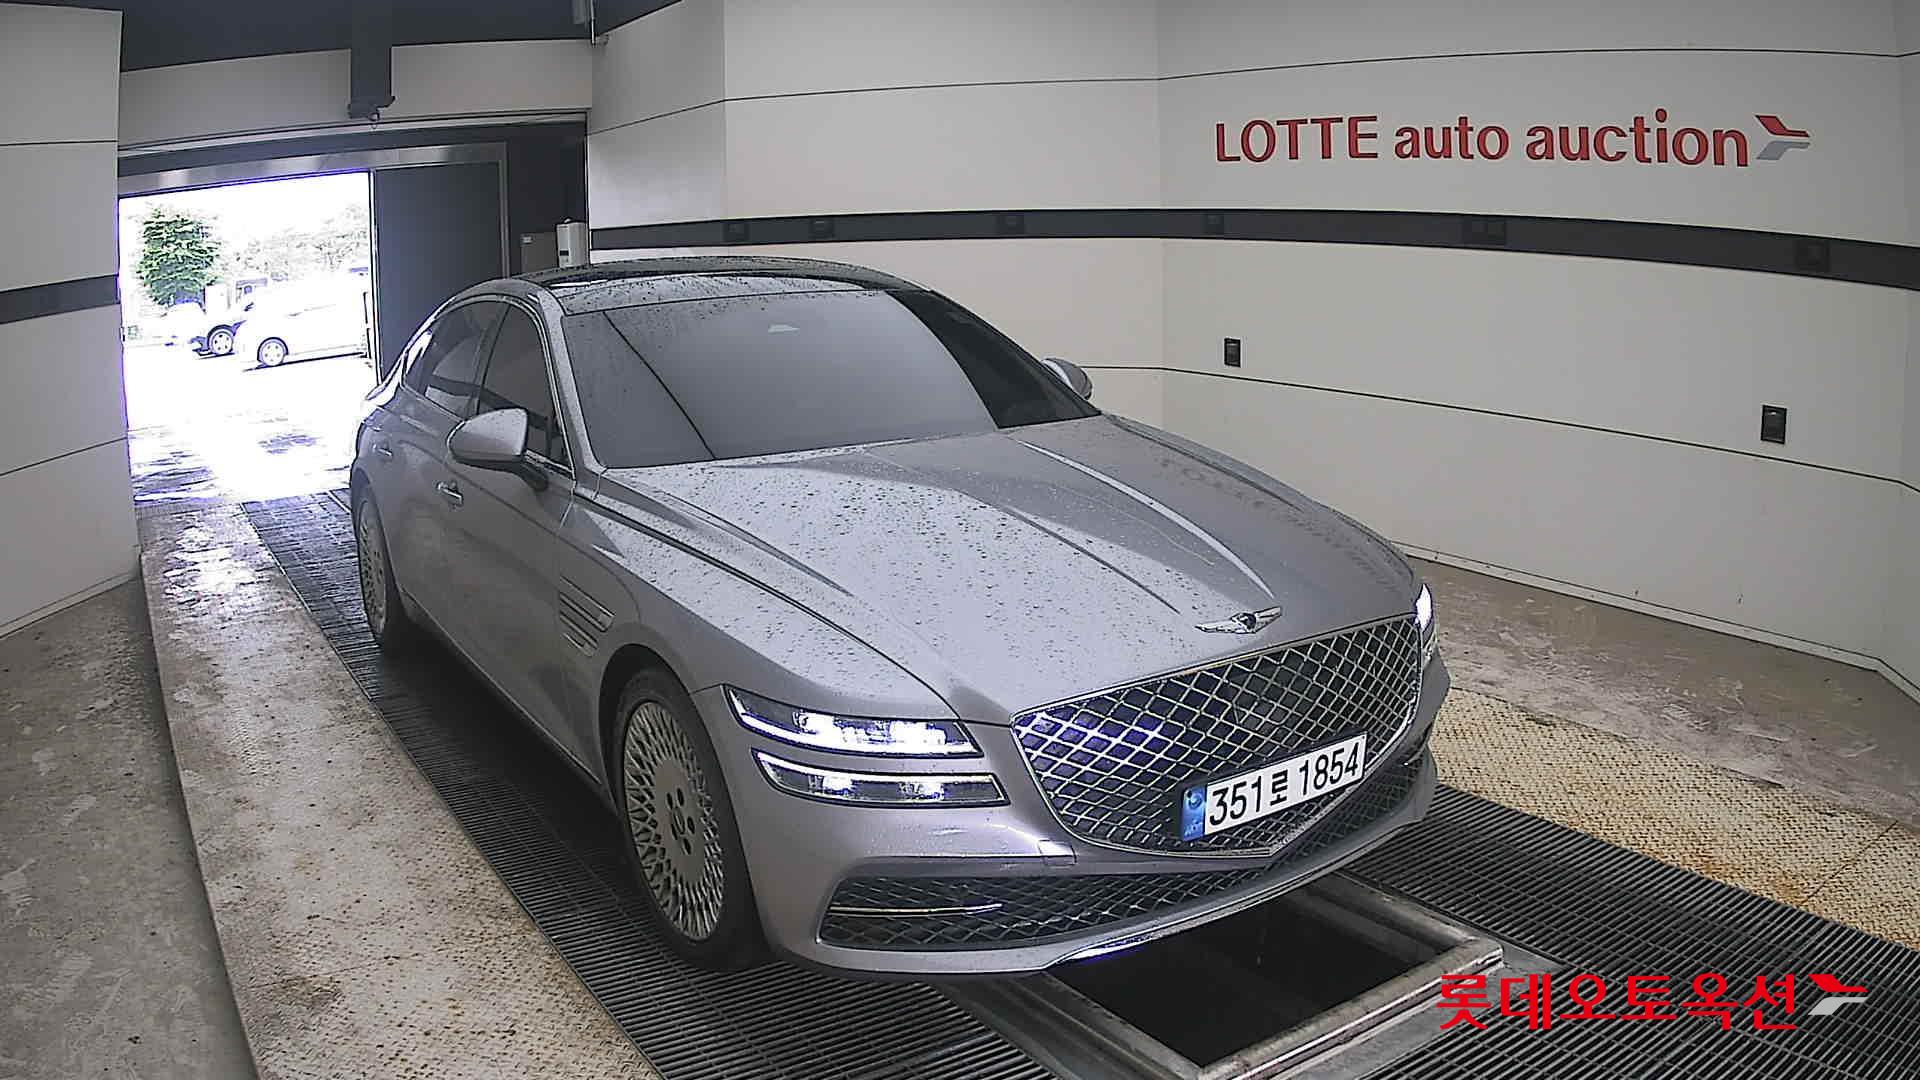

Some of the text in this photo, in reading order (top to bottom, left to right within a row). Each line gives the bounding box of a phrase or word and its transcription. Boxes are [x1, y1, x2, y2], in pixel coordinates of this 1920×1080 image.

[1215, 108, 1749, 167] LOTTE auto auction
[1209, 742, 1360, 826] 351로 1854
